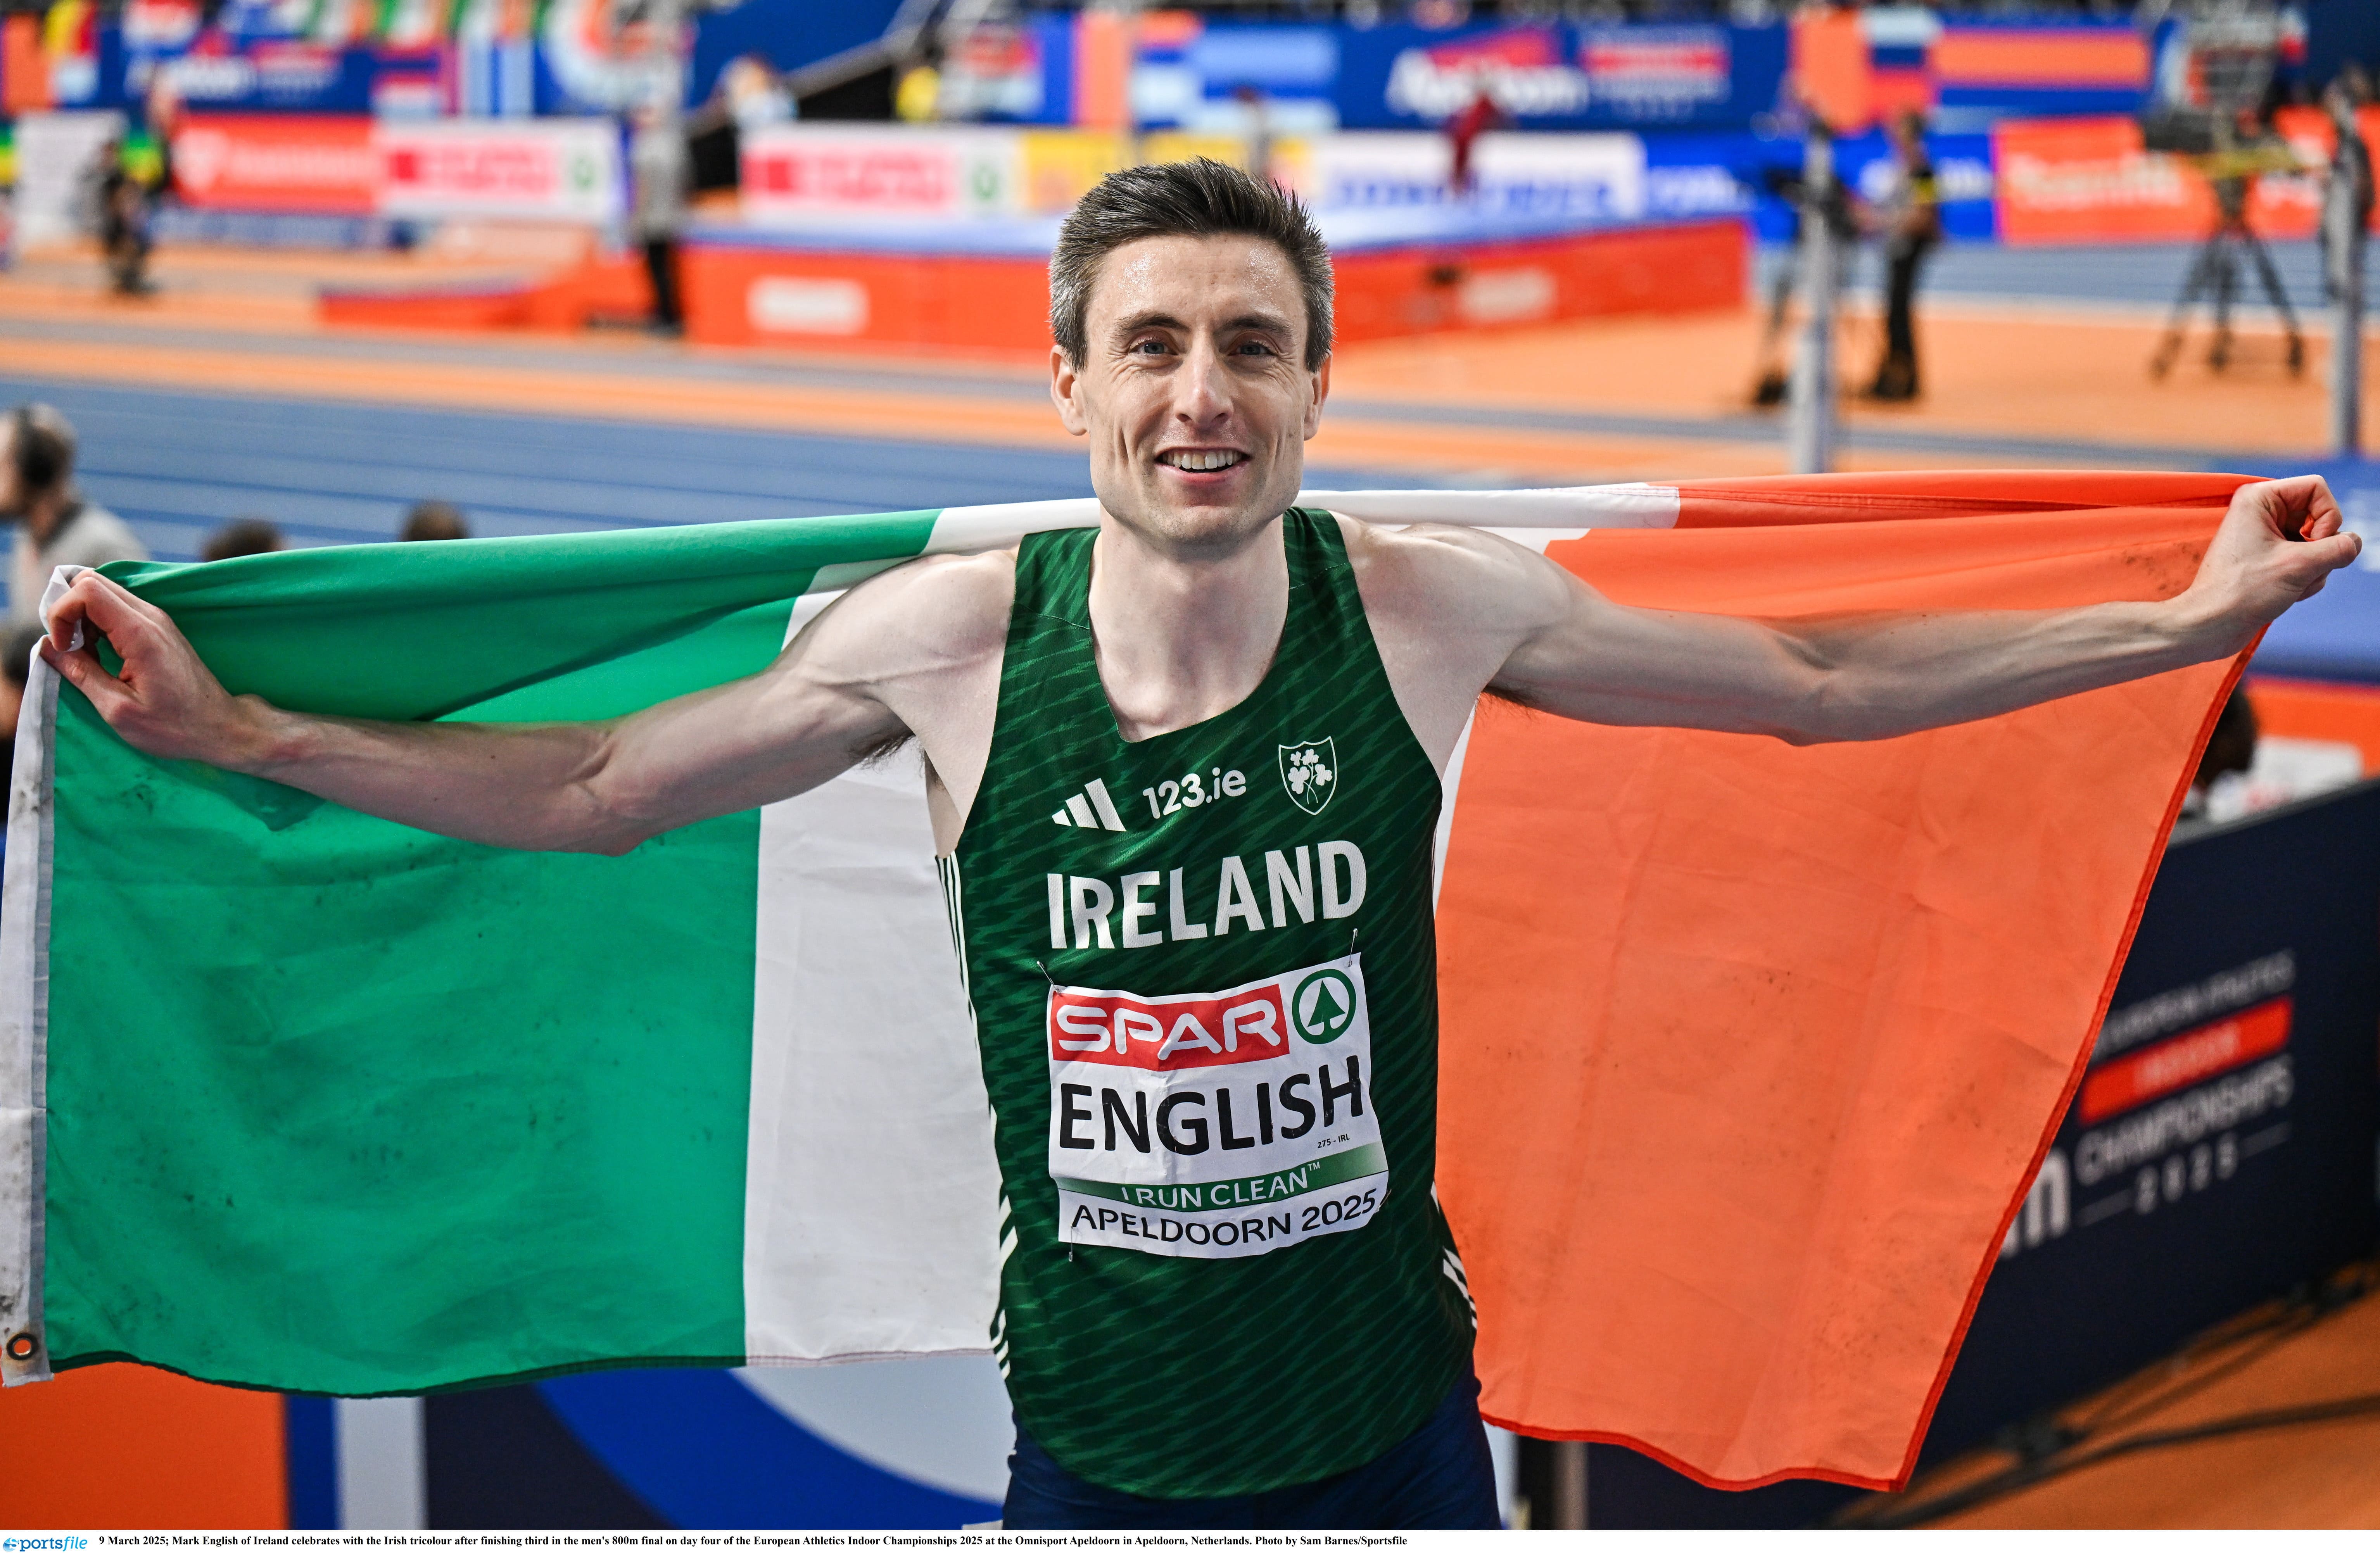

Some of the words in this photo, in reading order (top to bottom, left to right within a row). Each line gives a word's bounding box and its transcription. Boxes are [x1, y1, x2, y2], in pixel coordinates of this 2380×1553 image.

[1142, 767, 1247, 819] 123.ie
[1047, 840, 1367, 949] IRELAND
[1056, 998, 1281, 1060] SPAR
[1059, 1055, 1364, 1156] ENGLISH
[1318, 1138, 1331, 1148] 275
[1338, 1134, 1350, 1143] IRL
[1072, 1204, 1291, 1246] APELDOORN
[1302, 1188, 1377, 1232] 2025
[1121, 1187, 1129, 1201] I
[1135, 1187, 1202, 1208] RUN
